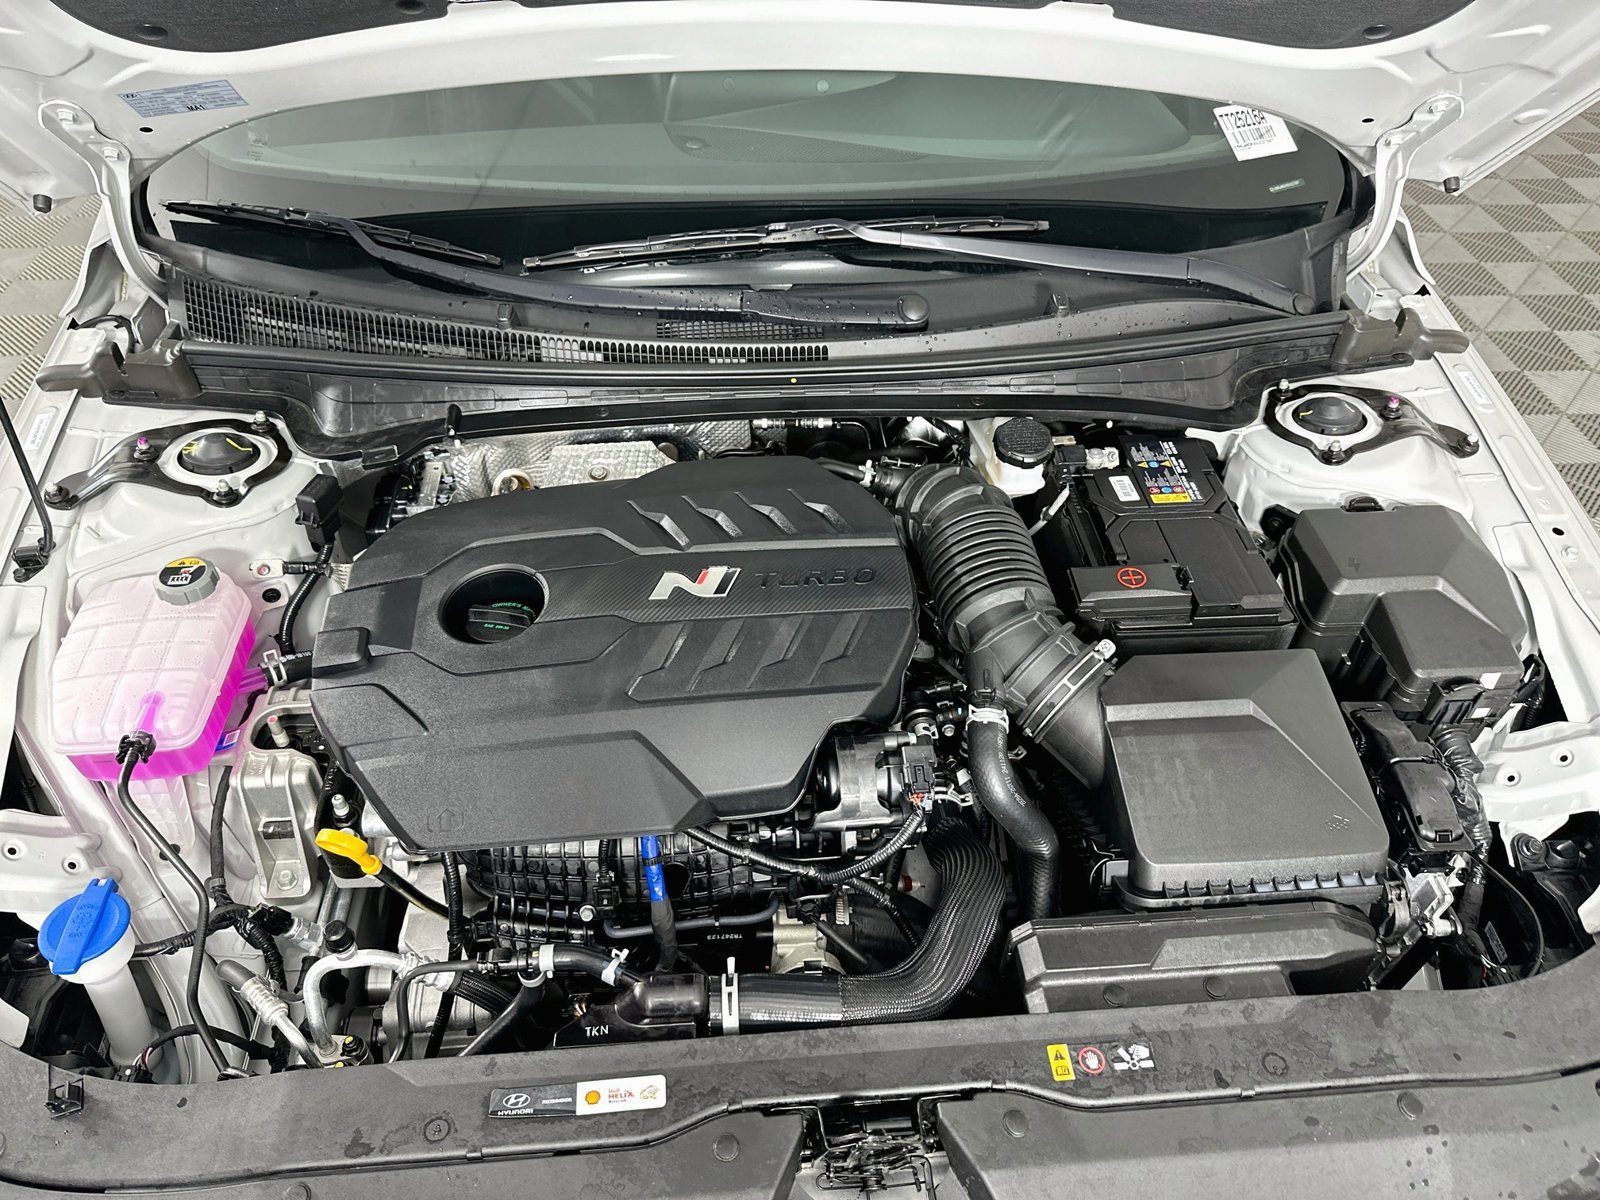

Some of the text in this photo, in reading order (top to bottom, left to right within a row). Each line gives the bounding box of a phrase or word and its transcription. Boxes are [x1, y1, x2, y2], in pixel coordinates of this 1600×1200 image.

[755, 568, 878, 589] TURBO
[584, 1024, 609, 1038] TKN
[608, 1090, 635, 1099] HELIX
[497, 1108, 534, 1116] HYUNDAI
